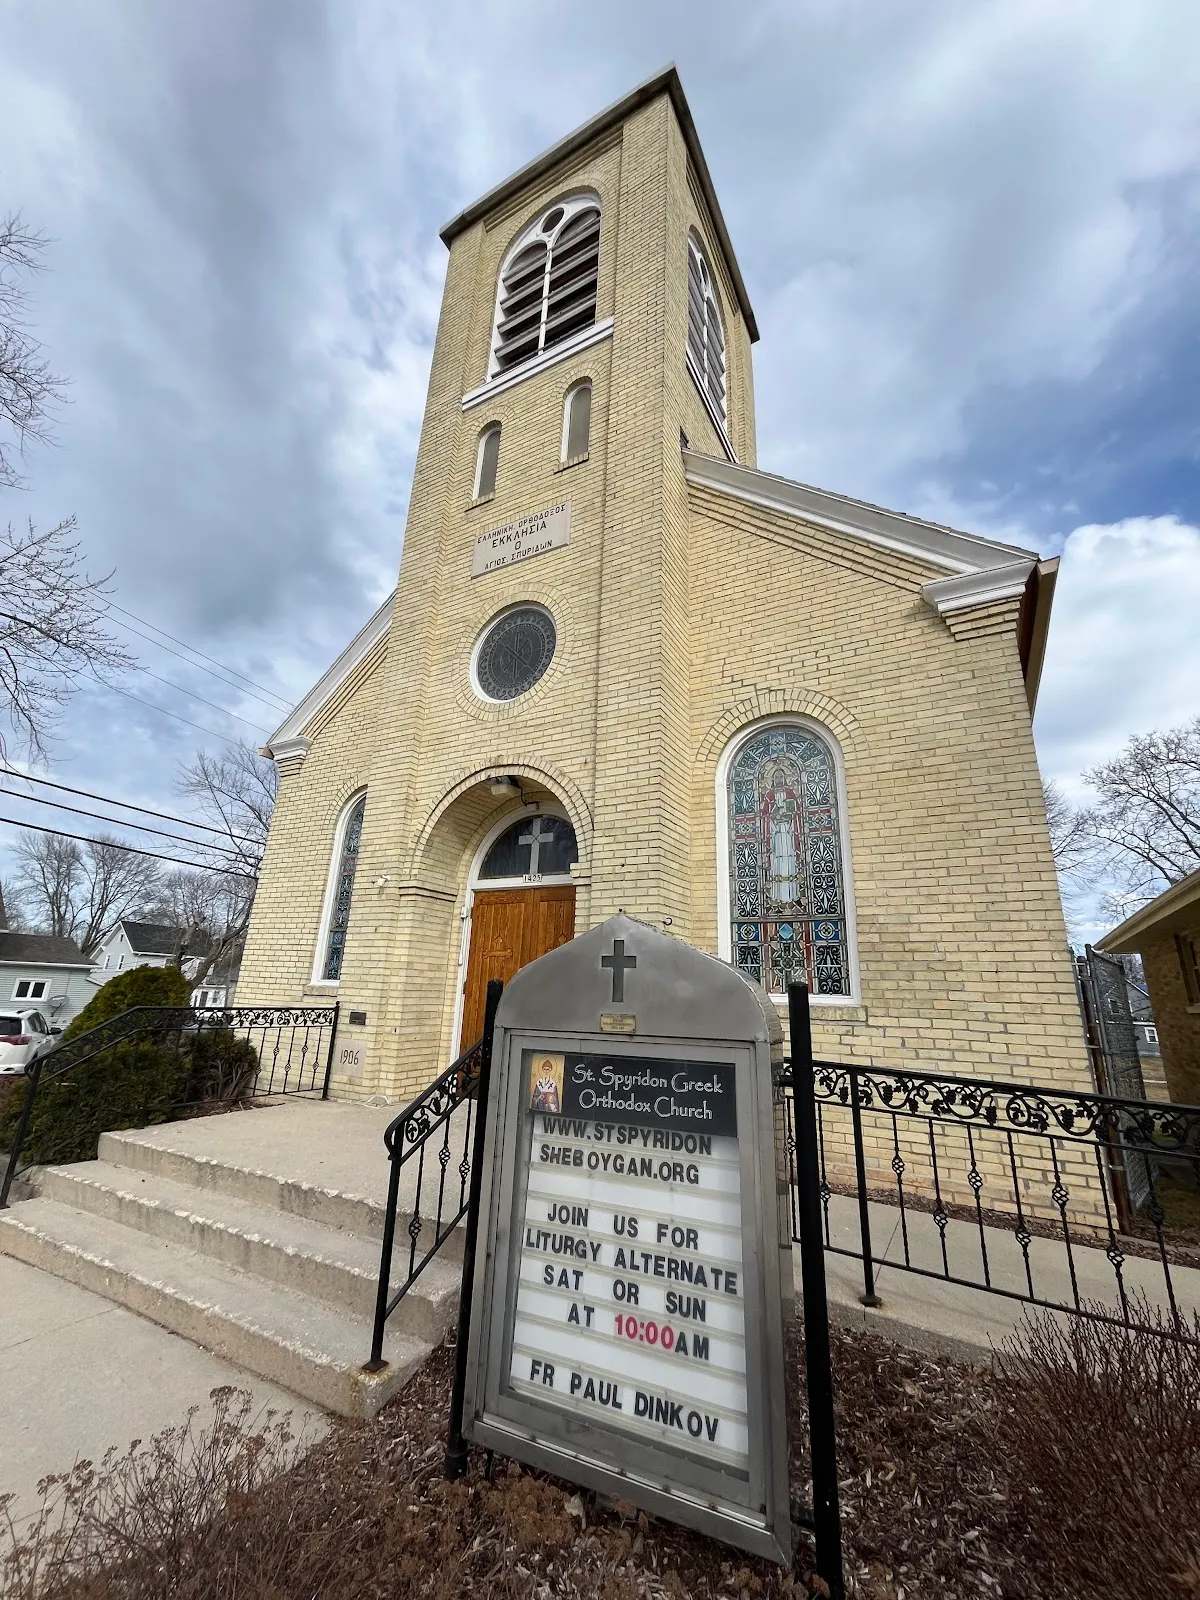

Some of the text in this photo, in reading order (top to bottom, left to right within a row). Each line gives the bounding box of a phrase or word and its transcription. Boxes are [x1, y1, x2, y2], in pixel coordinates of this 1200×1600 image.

[492, 520, 547, 548] ΕΚΚΛΗΣΙΑ
[340, 1049, 360, 1065] 1906
[571, 1063, 724, 1094] St. Spyridon Greek
[578, 1088, 713, 1120] Orthodox Church
[547, 1203, 699, 1250] JOIN US FOR
[525, 1227, 738, 1295] LITURGY ALTERNATE
[543, 1264, 707, 1322] SAT OR SUN
[567, 1302, 710, 1361] AT 10:00AM
[529, 1359, 719, 1442] FR PAUL DINKOV
